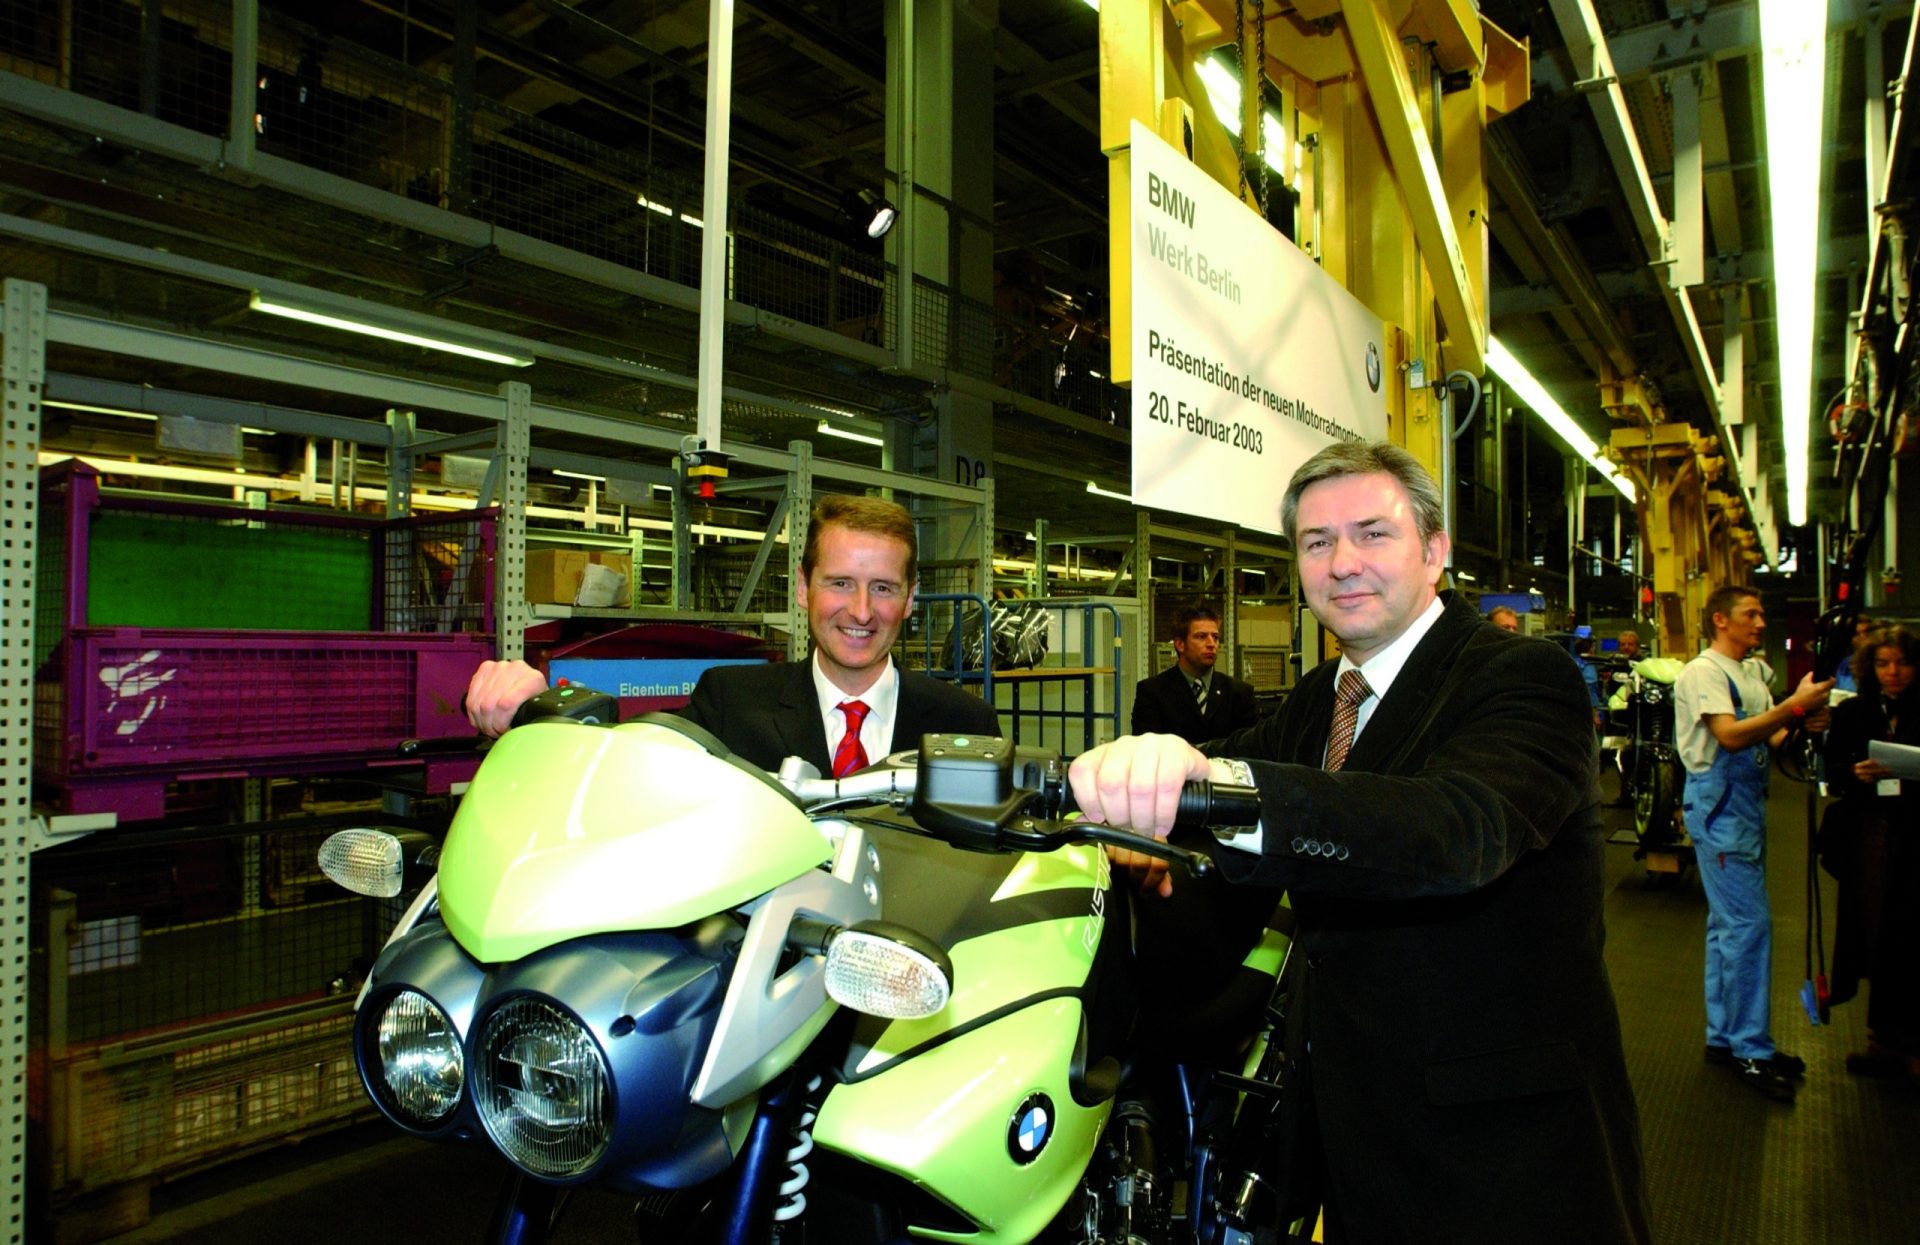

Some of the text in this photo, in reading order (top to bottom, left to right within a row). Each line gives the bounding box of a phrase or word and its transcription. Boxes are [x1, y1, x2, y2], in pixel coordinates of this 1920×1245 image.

[1148, 171, 1195, 230] BMW
[1148, 222, 1241, 305] Werk Berlin
[1149, 329, 1240, 395] Präsentation
[1242, 375, 1261, 403] der
[1263, 389, 1295, 420] neuen
[1148, 391, 1263, 455] 20. Februar 2003
[620, 682, 679, 697] Eigentum
